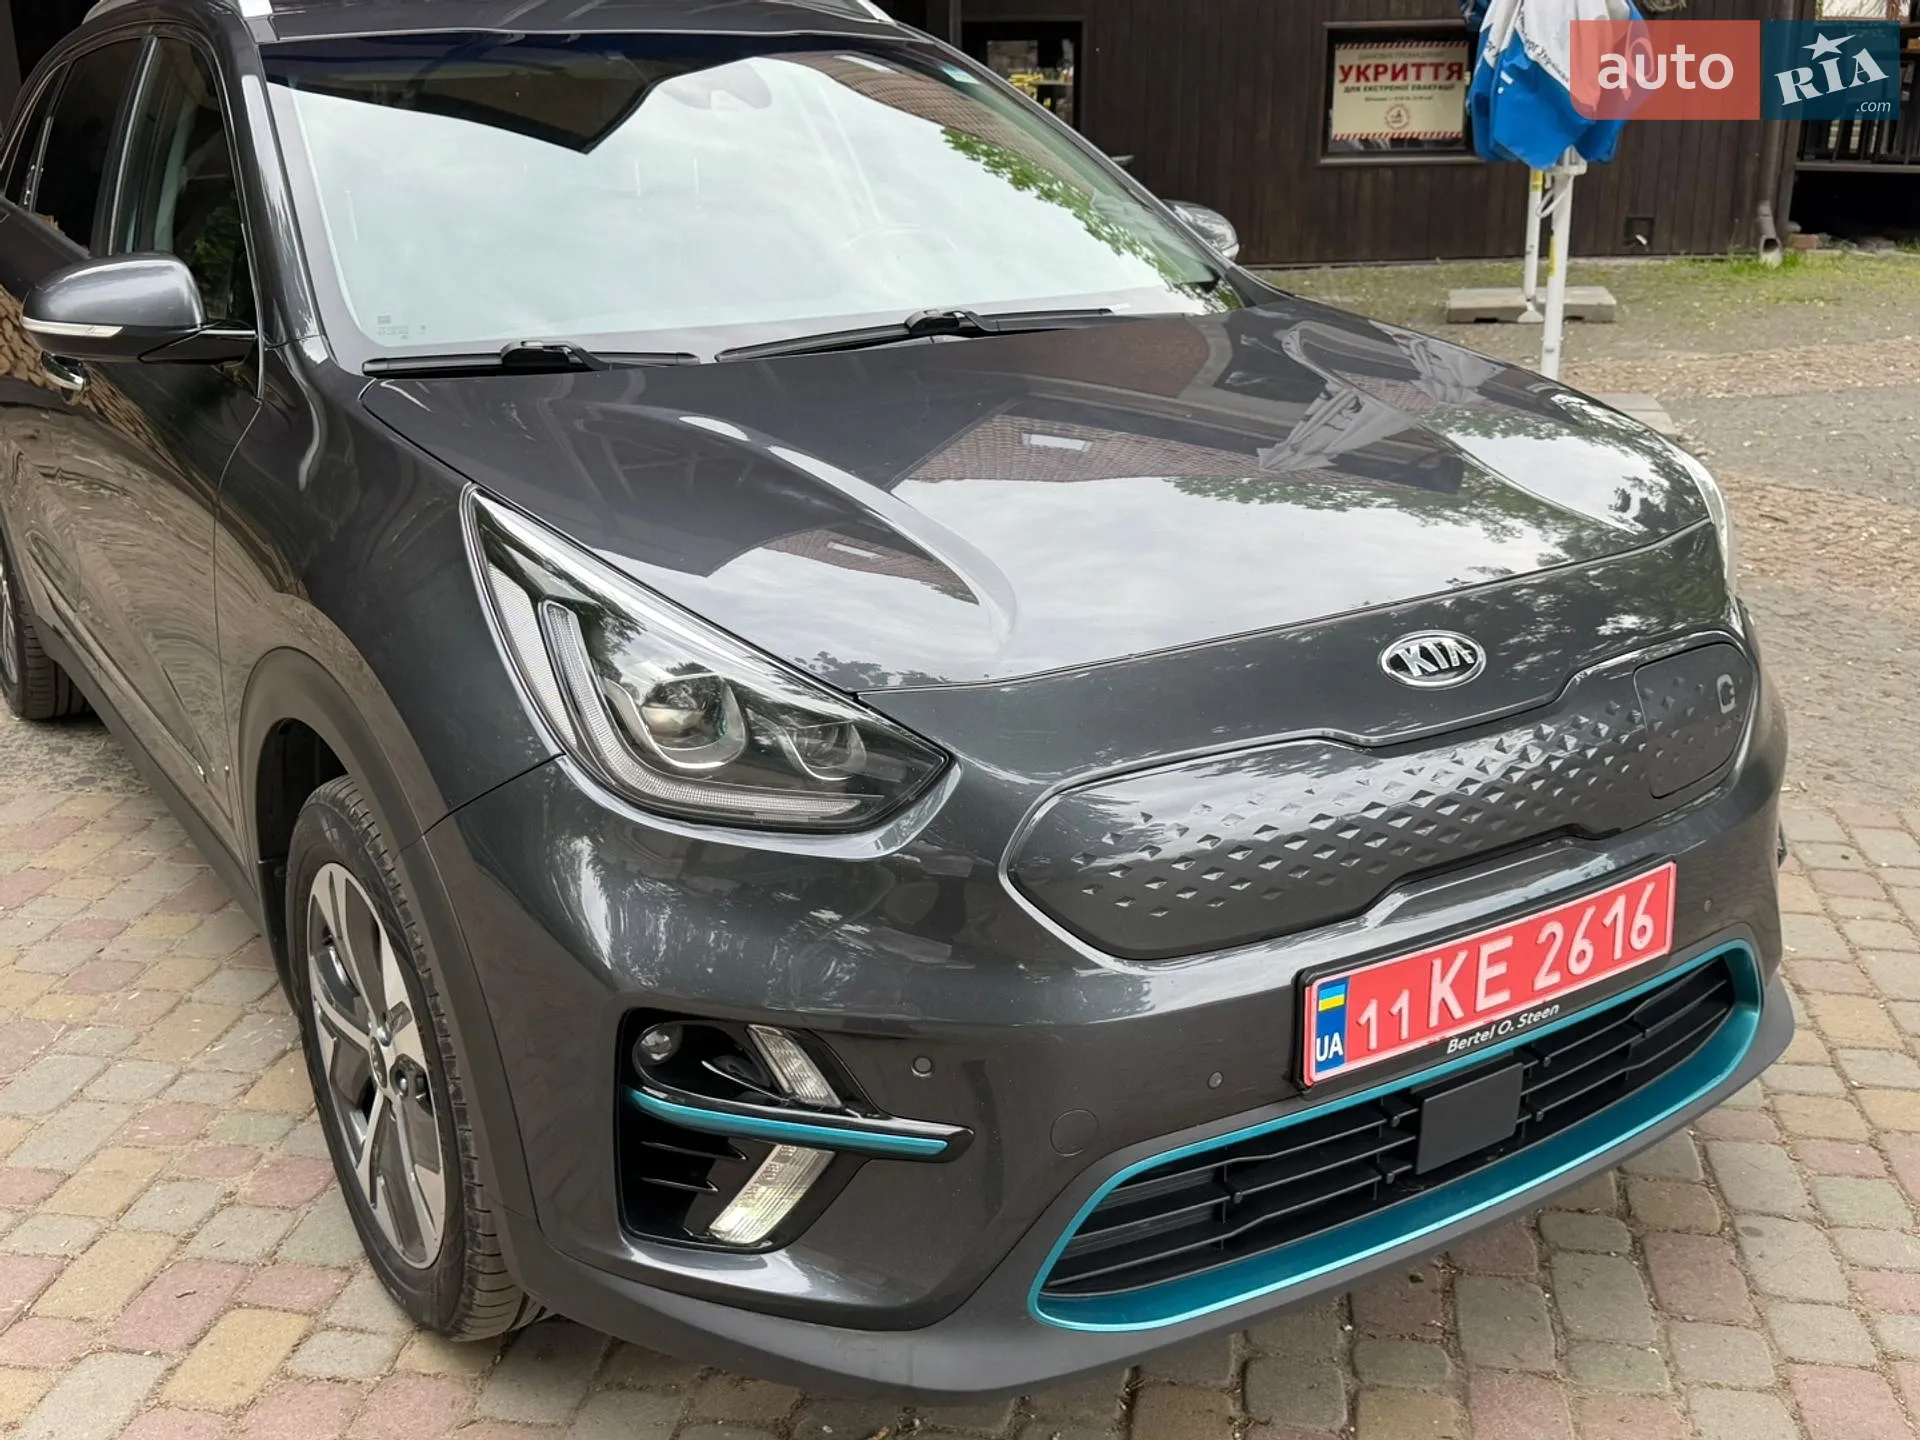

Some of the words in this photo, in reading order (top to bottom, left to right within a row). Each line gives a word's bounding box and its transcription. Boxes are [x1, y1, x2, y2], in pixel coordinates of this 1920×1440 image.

[1339, 61, 1465, 84] УКРИТТЯ
[1394, 640, 1476, 677] KIA
[1533, 881, 1656, 993] 2616
[1315, 1032, 1344, 1062] UA
[1446, 1023, 1496, 1055] Bertel
[1497, 1019, 1515, 1035] O.
[1516, 1003, 1560, 1029] Steen
